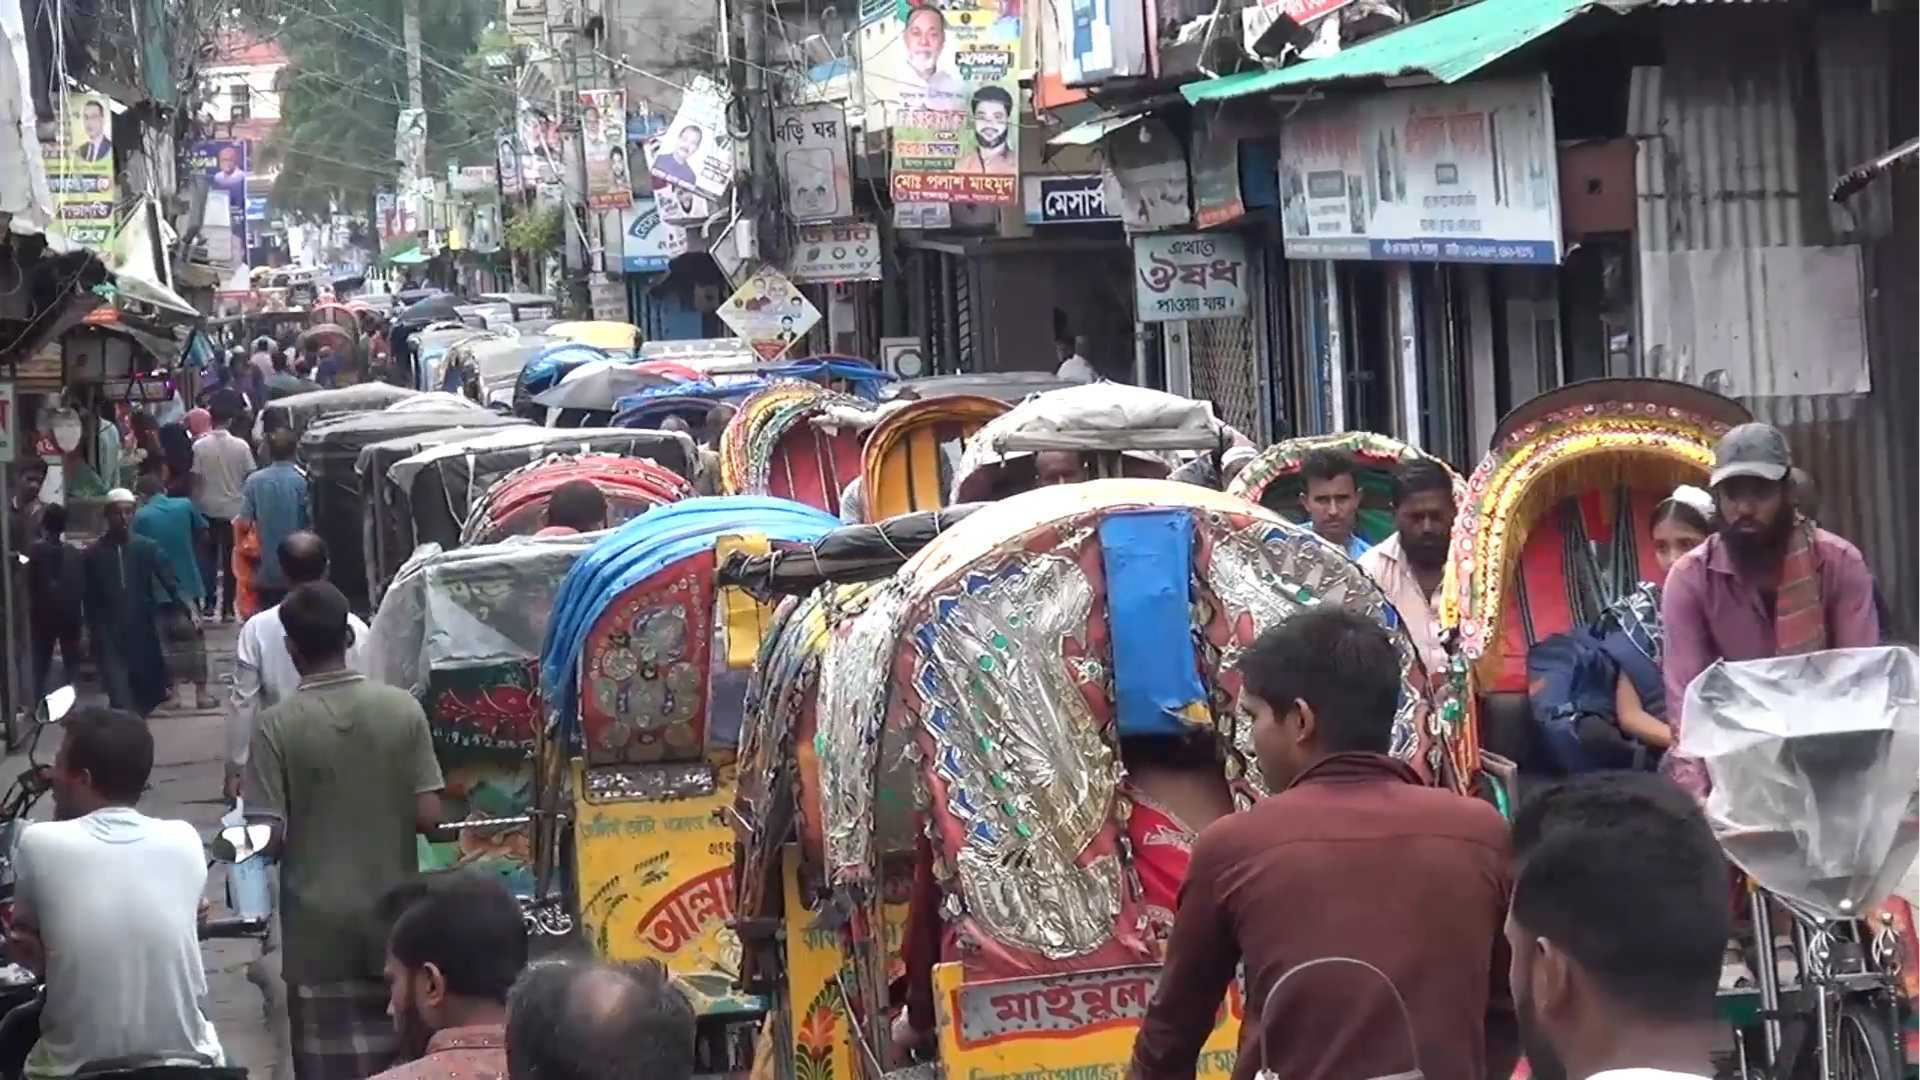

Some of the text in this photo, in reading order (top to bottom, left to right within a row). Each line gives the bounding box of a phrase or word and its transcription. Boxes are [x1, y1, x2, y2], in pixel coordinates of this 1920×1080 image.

[812, 120, 837, 139] ঘর
[894, 174, 1014, 195] মোঃ পলাশ মাহমুদ
[1045, 182, 1106, 217] মেসার্স
[1139, 251, 1242, 294] ঔষধ
[1156, 297, 1200, 312] পাওয়া
